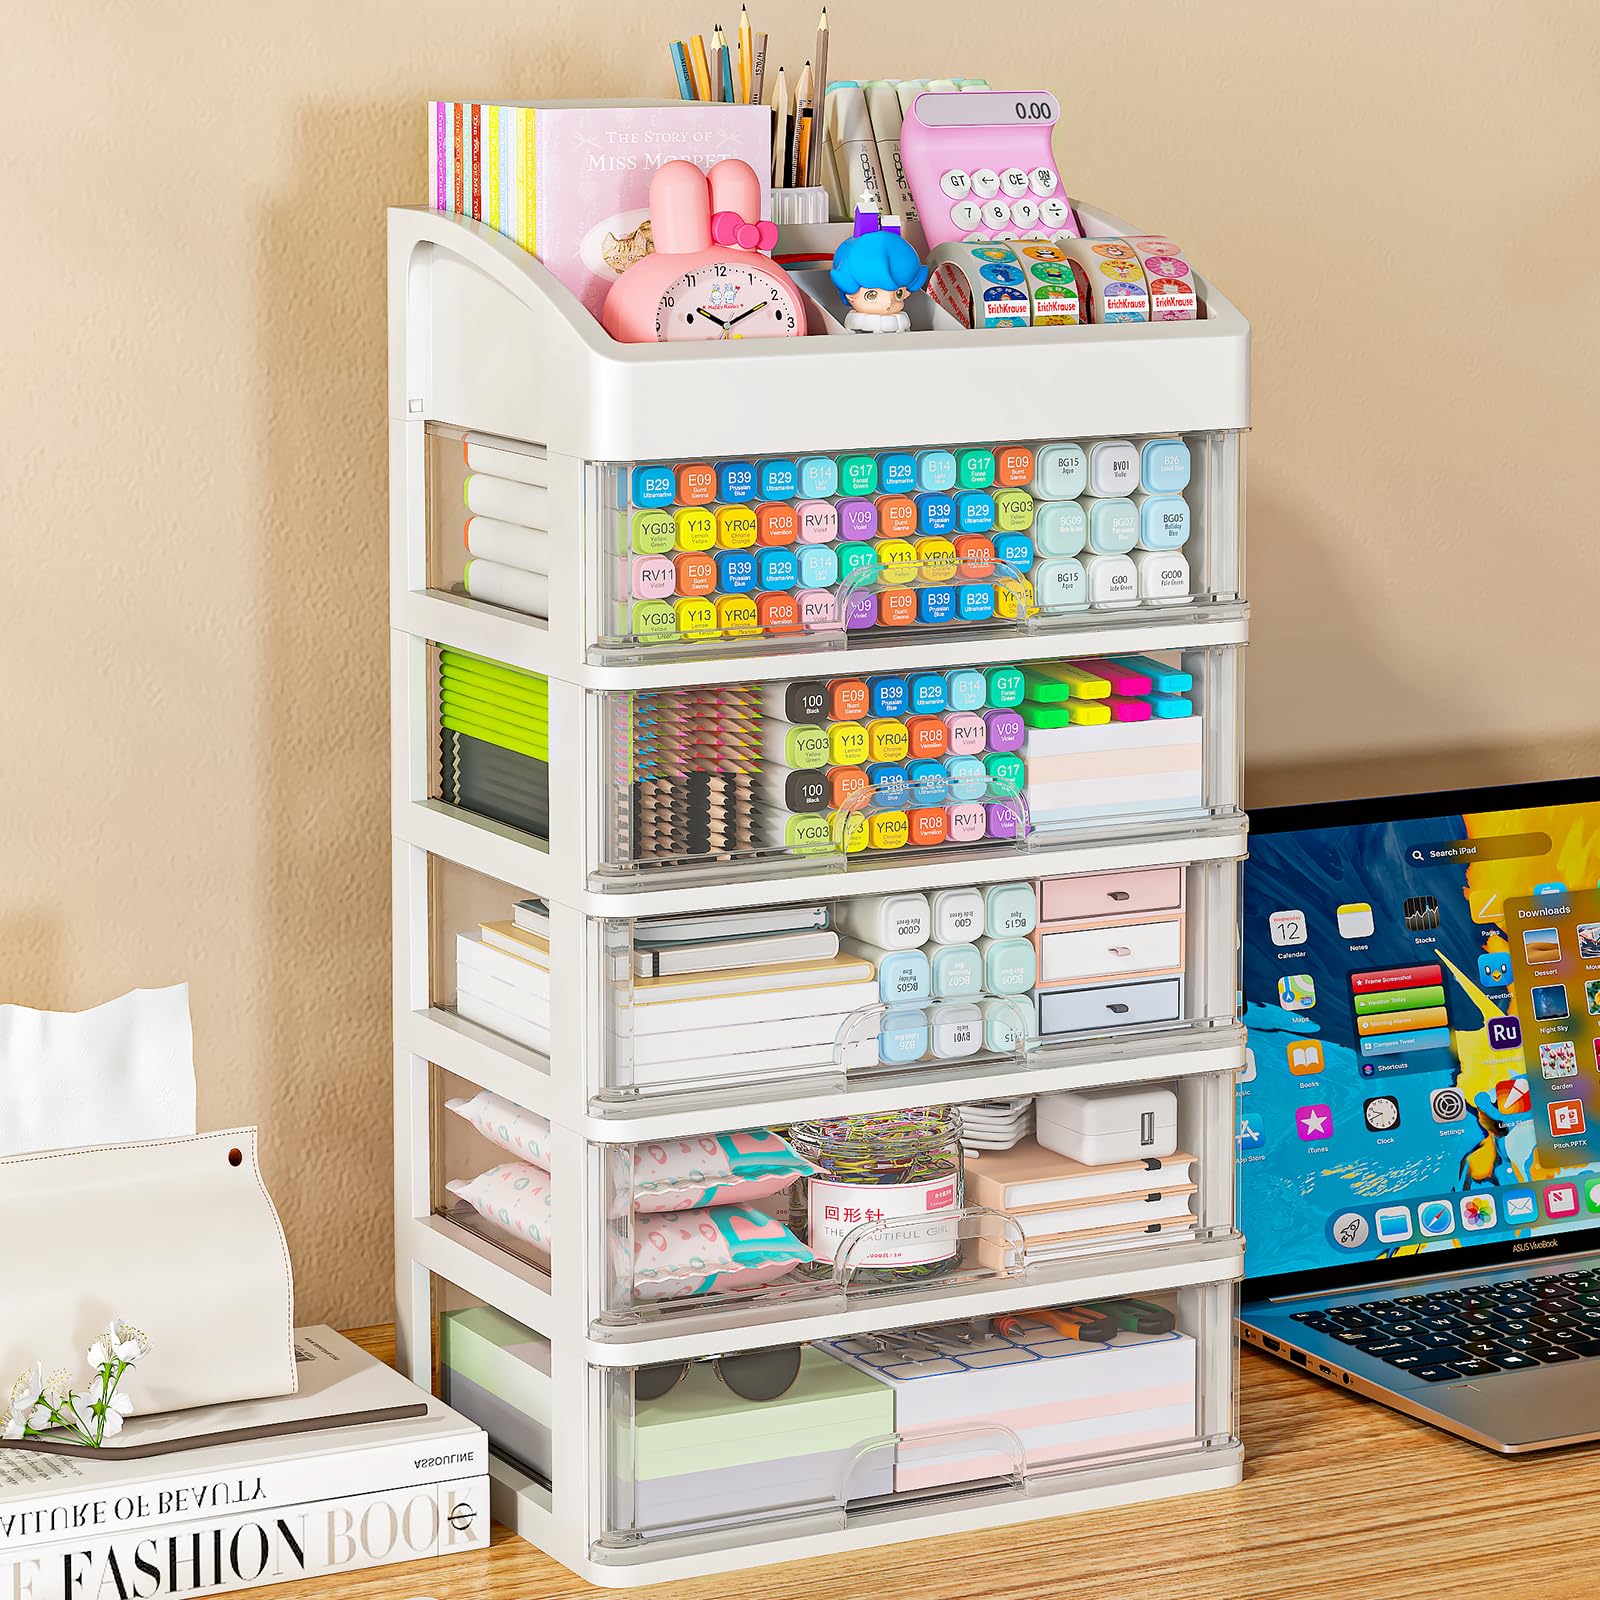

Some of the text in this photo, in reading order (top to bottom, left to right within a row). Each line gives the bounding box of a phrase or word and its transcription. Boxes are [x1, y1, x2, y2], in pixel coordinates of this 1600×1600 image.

[1016, 102, 1051, 119] 0.00
[587, 153, 638, 171] MISS
[950, 176, 965, 187] GT
[1008, 174, 1026, 185] CE
[964, 206, 1031, 218] 7 8 9
[714, 266, 727, 277] 12
[685, 274, 696, 287] 11
[748, 273, 753, 285] 1
[663, 296, 675, 307] 10
[770, 290, 779, 301] 2
[1155, 295, 1194, 307] ErichKrause
[987, 302, 1027, 315] ErichKrause
[1037, 300, 1076, 312] ErichKrause
[1107, 298, 1146, 310] ErichKrause
[787, 317, 795, 328] 3
[928, 460, 951, 472] B14
[967, 458, 991, 470] G17
[1007, 456, 1029, 468] E09
[1058, 457, 1079, 467] BG15
[1113, 460, 1130, 471] BV01
[1164, 456, 1180, 465] B26
[809, 466, 832, 479] B14
[849, 464, 873, 477] G17
[889, 465, 911, 477] B29
[688, 474, 712, 487] E09
[728, 472, 752, 484] B39
[769, 472, 792, 485] B29
[886, 477, 914, 485] Ultramarine
[646, 479, 670, 491] B29
[766, 484, 794, 492] Ultramarine
[643, 491, 672, 499] Ultramarine
[890, 507, 913, 519] E09
[928, 504, 950, 517] B39
[967, 505, 989, 517] B29
[1002, 501, 1033, 513] YG03
[769, 517, 792, 529] R08
[805, 514, 837, 527] RV11
[849, 511, 872, 524] V09
[964, 517, 992, 525] Ultramarine
[1163, 514, 1184, 523] BG05
[641, 522, 675, 535] YG03
[688, 519, 711, 532] Y13
[724, 519, 756, 532] YR04
[1006, 547, 1028, 559] B29
[809, 557, 832, 570] B14
[849, 554, 873, 566] G17
[688, 565, 712, 578] E09
[728, 562, 752, 575] B39
[769, 563, 792, 575] B29
[1161, 570, 1183, 579] G000
[642, 569, 673, 582] RV11
[766, 574, 795, 582] Ultramarine
[1057, 573, 1079, 582] BG15
[1112, 575, 1128, 585] G00
[890, 595, 912, 608] E09
[928, 593, 950, 606] B39
[967, 593, 989, 605] B29
[688, 609, 711, 622] Y13
[724, 609, 757, 622] YR04
[769, 606, 792, 618] R08
[642, 612, 676, 626] YG03
[959, 681, 981, 693] B14
[997, 677, 1021, 689] G17
[842, 690, 865, 701] E09
[880, 687, 903, 699] B39
[919, 687, 942, 699] B29
[802, 695, 823, 707] 100
[954, 727, 985, 739] RV11
[996, 723, 1019, 735] V09
[841, 734, 864, 746] Y13
[877, 733, 908, 745] YR04
[919, 730, 943, 742] R08
[797, 738, 830, 751] YG03
[997, 765, 1020, 777] G17
[802, 785, 823, 797] 100
[842, 779, 865, 791] E09
[919, 817, 943, 828] R08
[954, 814, 985, 826] RV11
[797, 826, 830, 839] YG03
[877, 821, 908, 833] YR04
[1429, 846, 1477, 858] Search iPad
[1518, 905, 1571, 919] Downloads
[955, 918, 971, 928] G00
[1005, 918, 1027, 928] BG15
[898, 925, 920, 936] G000
[1277, 922, 1301, 941] 12
[1414, 937, 1436, 945] Stocks
[1350, 944, 1369, 952] Notes
[1277, 951, 1306, 960] Calendar
[1534, 968, 1558, 977] Dessert
[897, 982, 919, 993] BG05
[1485, 992, 1514, 1000] Tweetbot
[1292, 1016, 1310, 1025] Maps
[1493, 1024, 1517, 1042] Ru
[1556, 1024, 1569, 1033] Sky
[953, 1030, 971, 1042] BV01
[1377, 1063, 1408, 1072] Shortcuts
[1299, 1081, 1319, 1089] Books
[1551, 1082, 1574, 1091] Garden
[1439, 1128, 1465, 1137] Settings
[1376, 1137, 1395, 1145] Clock
[1553, 1140, 1588, 1149] Pitch.PPTX
[1308, 1146, 1329, 1154] iTunes
[825, 1205, 885, 1223] 回形针
[824, 1224, 948, 1242] THE AUTIFUL GIRL
[1512, 1239, 1559, 1253] ASUS VivoBook
[62, 1488, 480, 1600] FASHION BOOK
